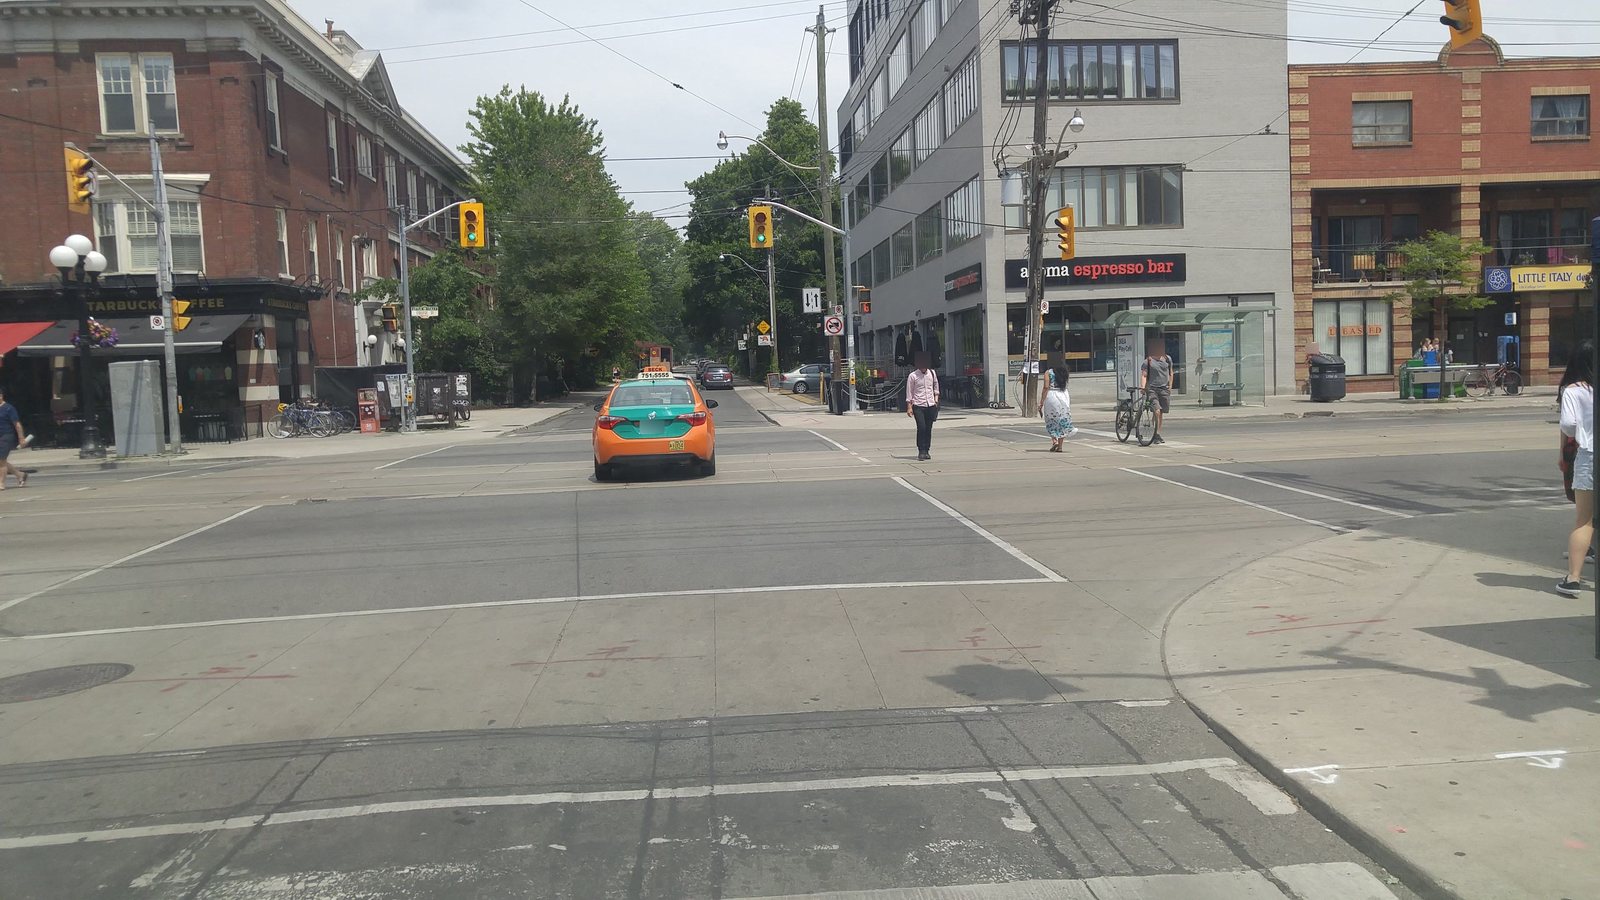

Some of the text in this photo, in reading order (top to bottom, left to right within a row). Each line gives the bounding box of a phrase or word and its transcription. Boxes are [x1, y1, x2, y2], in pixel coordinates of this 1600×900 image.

[1020, 260, 1174, 279] aoma espresso bar
[1518, 273, 1546, 283] LITTLE
[1549, 272, 1573, 282] ITALY
[86, 298, 225, 311] TARBUCK FFEE
[1329, 327, 1382, 335] LEASED
